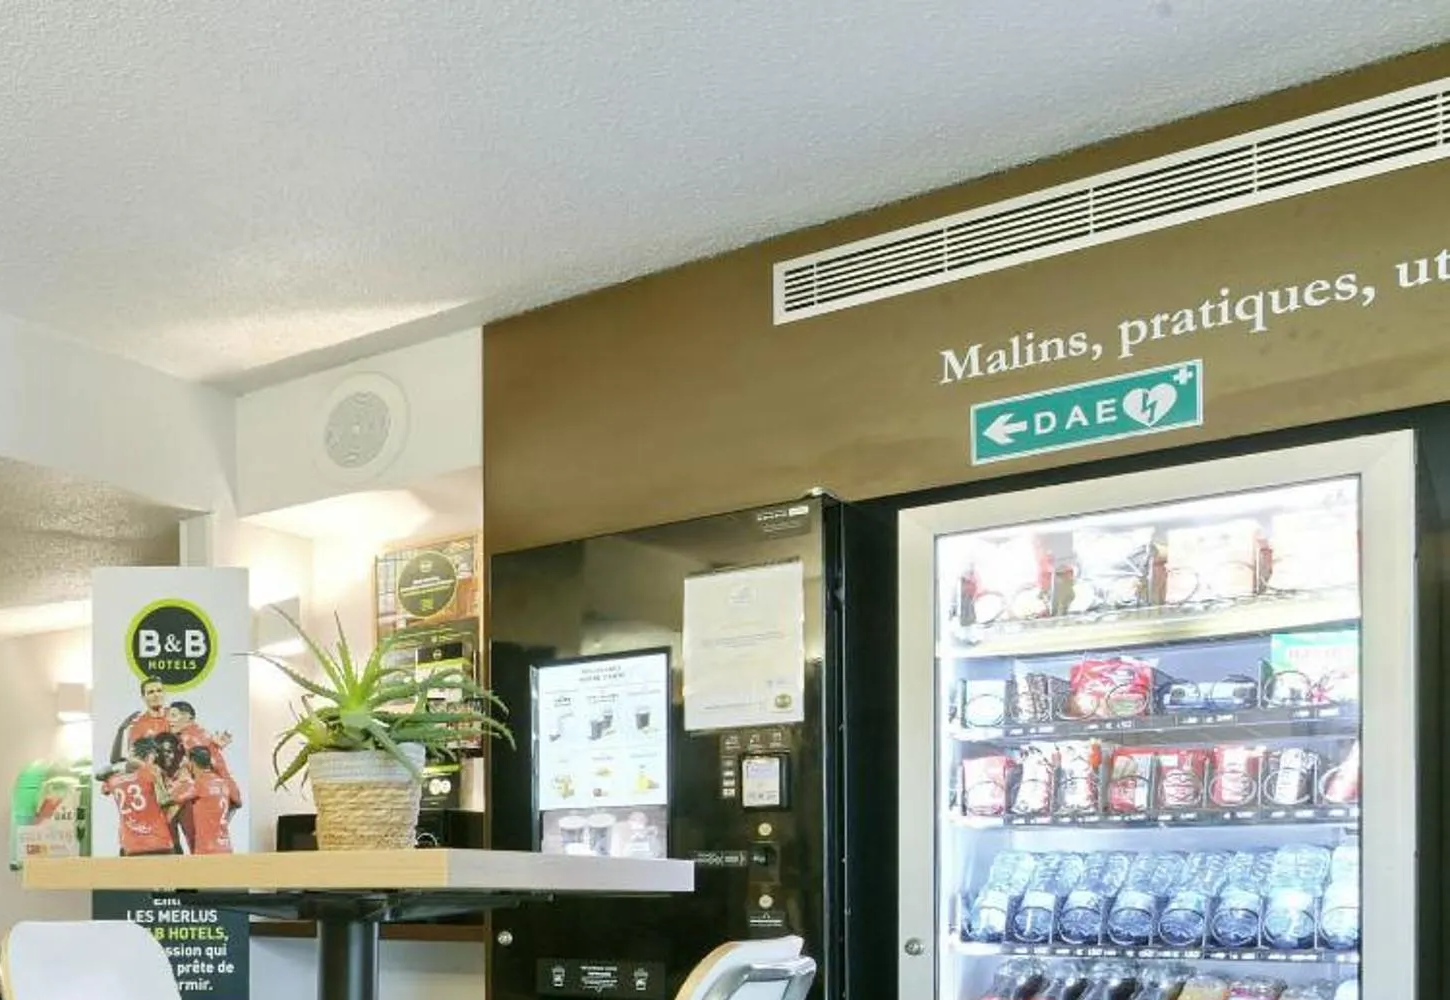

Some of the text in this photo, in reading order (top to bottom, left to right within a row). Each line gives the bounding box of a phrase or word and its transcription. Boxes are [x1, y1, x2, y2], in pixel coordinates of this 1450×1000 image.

[938, 330, 1103, 384] Malins,
[1117, 271, 1376, 359] pratiques,
[1033, 398, 1117, 435] DAE
[138, 629, 207, 658] B&B
[148, 659, 198, 670] HOTELS
[114, 784, 147, 815] 23
[127, 909, 218, 923] LES MERLUS
[169, 926, 229, 942] HOTELS,
[164, 943, 228, 960] ssion qui
[177, 958, 235, 977] prête de
[178, 978, 214, 991] rmir.
